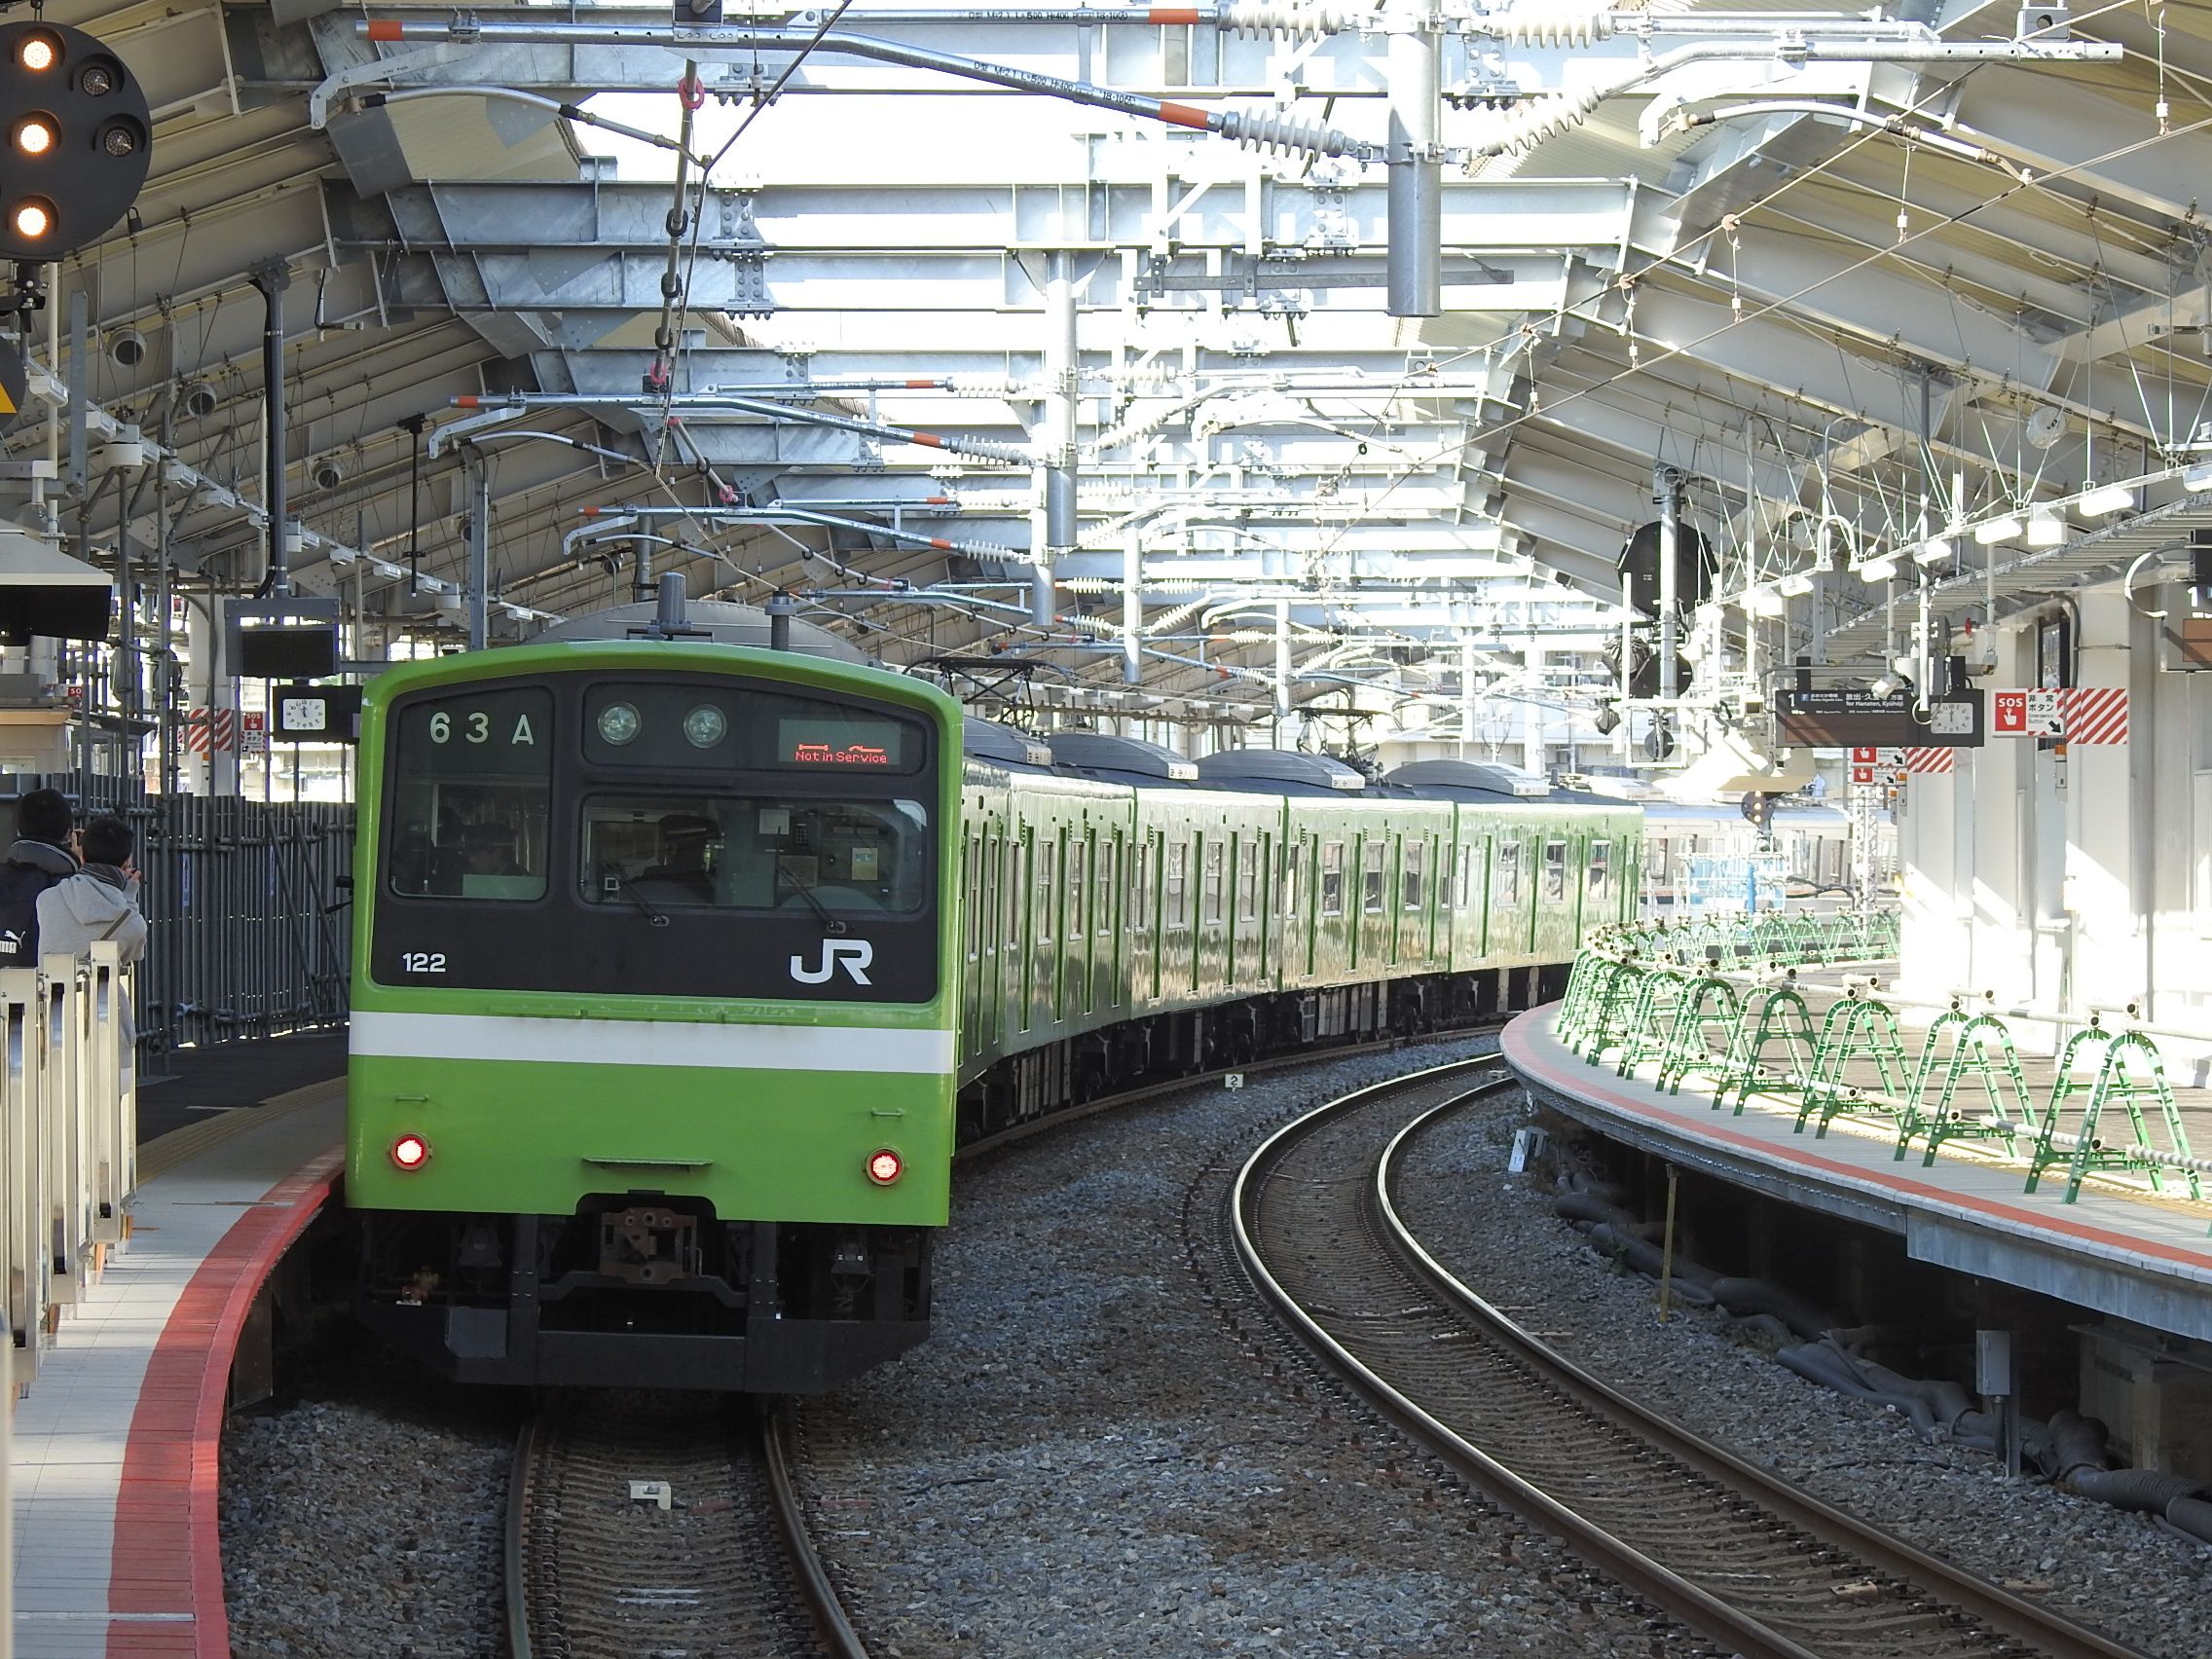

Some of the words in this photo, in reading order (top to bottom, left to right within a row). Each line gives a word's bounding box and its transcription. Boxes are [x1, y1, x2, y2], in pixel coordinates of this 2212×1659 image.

[2187, 586, 2197, 608] 1
[1788, 693, 1795, 708] 1
[1999, 697, 2023, 708] SOS
[794, 751, 820, 762] Not
[823, 751, 833, 762] in
[835, 752, 888, 764] Service
[402, 952, 446, 973] 122
[790, 939, 873, 985] JR
[1230, 1075, 1238, 1087] 2
